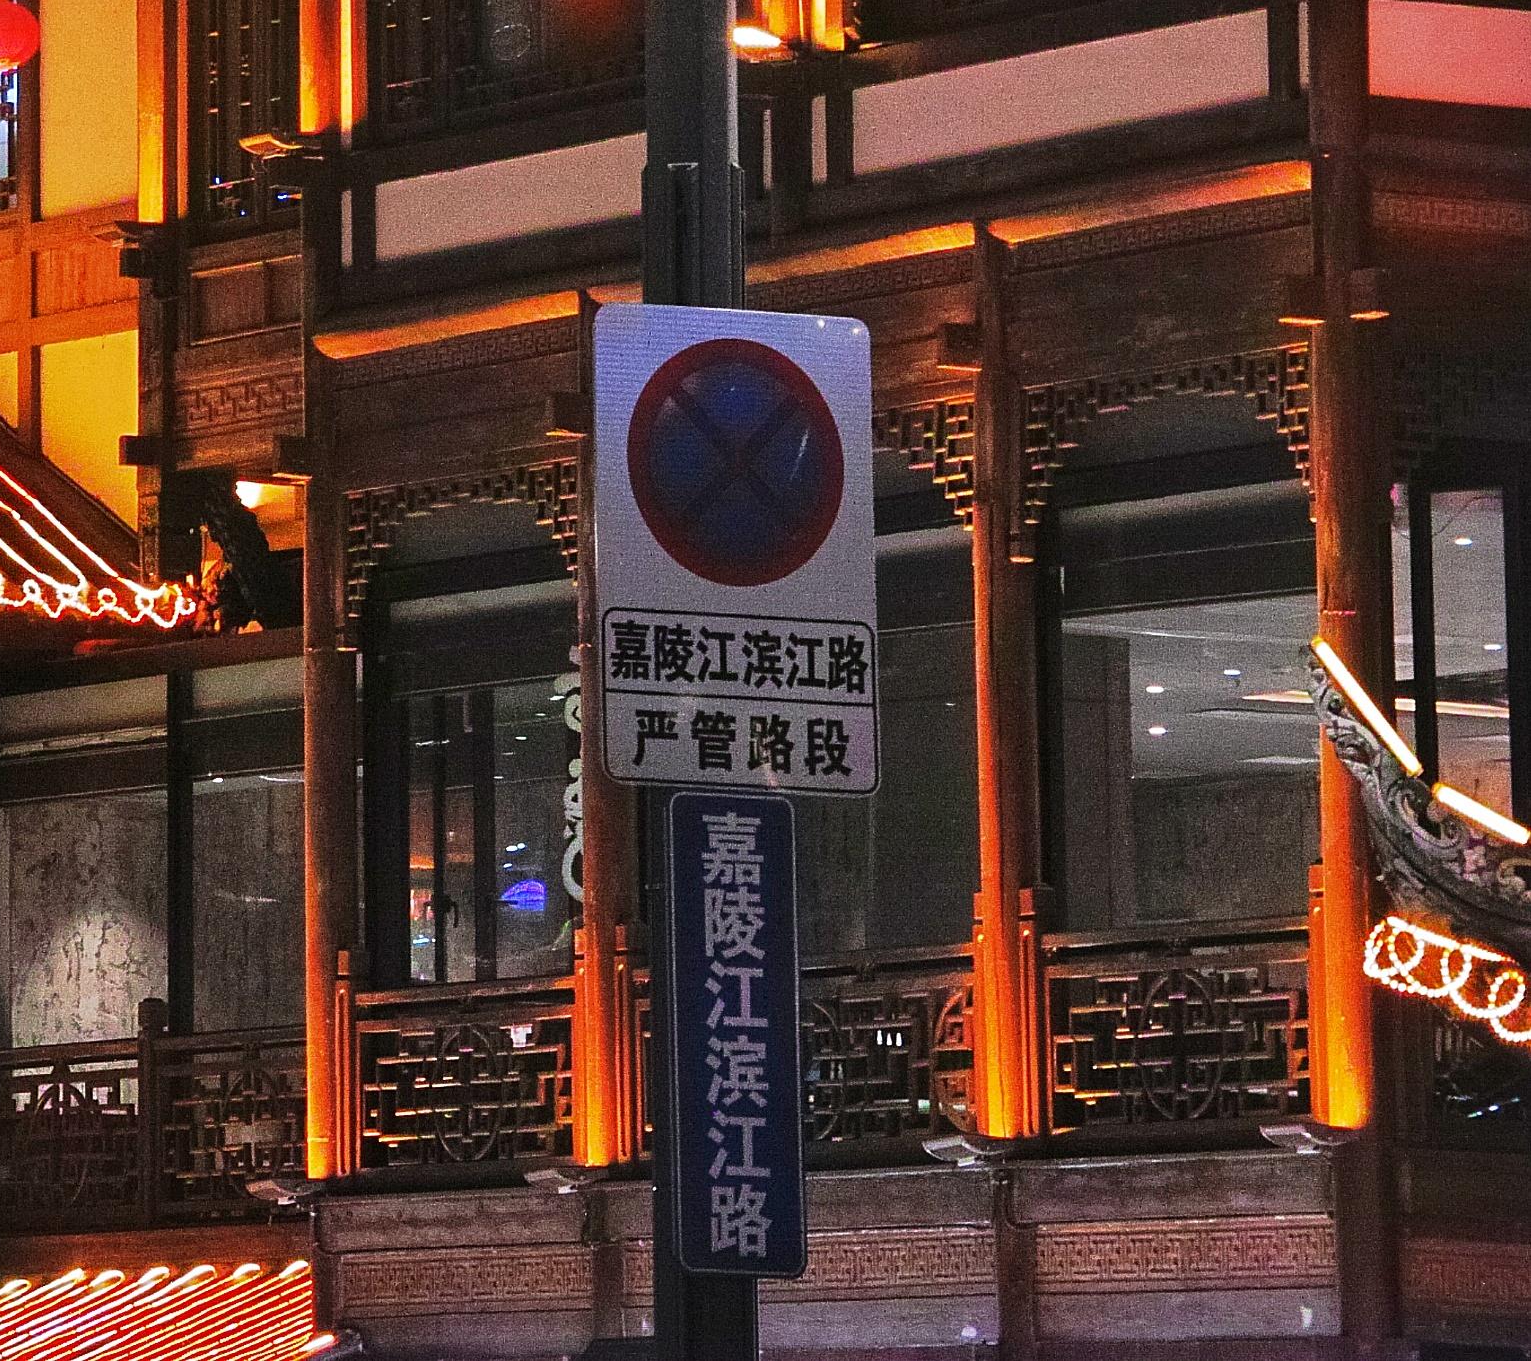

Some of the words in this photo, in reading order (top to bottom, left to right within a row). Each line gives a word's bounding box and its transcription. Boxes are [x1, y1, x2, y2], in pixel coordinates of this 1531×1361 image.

[609, 621, 870, 696] 嘉陵江滨江路
[633, 708, 853, 780] 严管路段
[700, 812, 774, 1259] 嘉陵江滨江路
